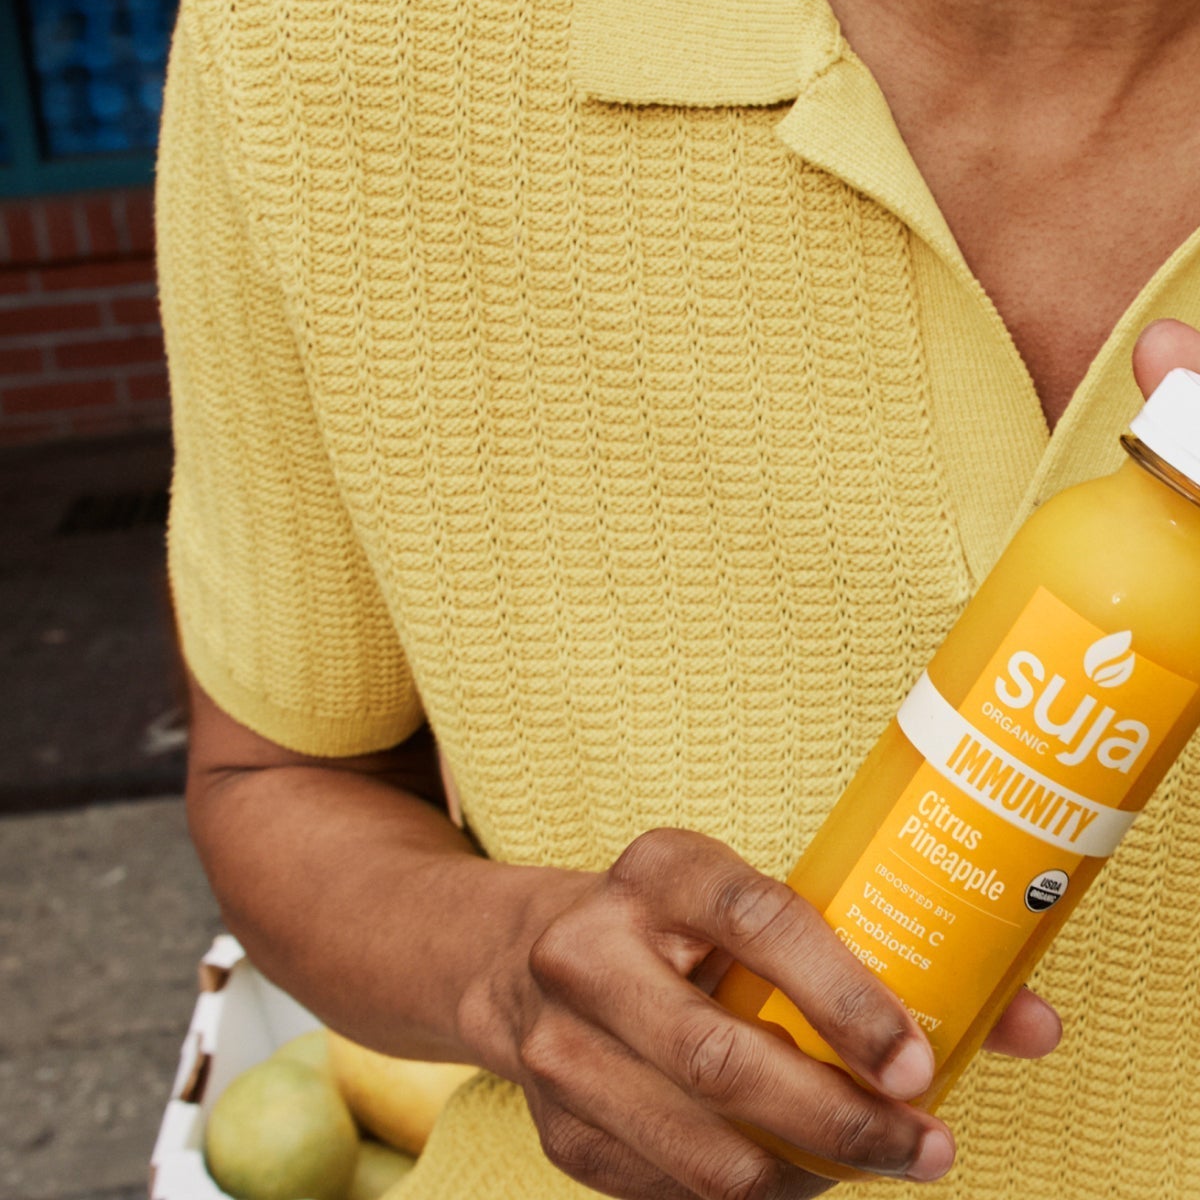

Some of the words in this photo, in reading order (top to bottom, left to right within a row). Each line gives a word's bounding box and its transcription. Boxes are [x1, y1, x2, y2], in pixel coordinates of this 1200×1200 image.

[980, 701, 1050, 756] ORGANIC
[994, 650, 1150, 775] suja
[917, 790, 984, 851] Citrus
[945, 733, 1099, 843] IMMUNITY
[897, 815, 1006, 902] Pineapple
[1040, 877, 1063, 892] USDA
[846, 903, 933, 971] Probiotics
[861, 880, 927, 939] Vitamin
[927, 930, 945, 947] C
[834, 925, 888, 974] Ginger
